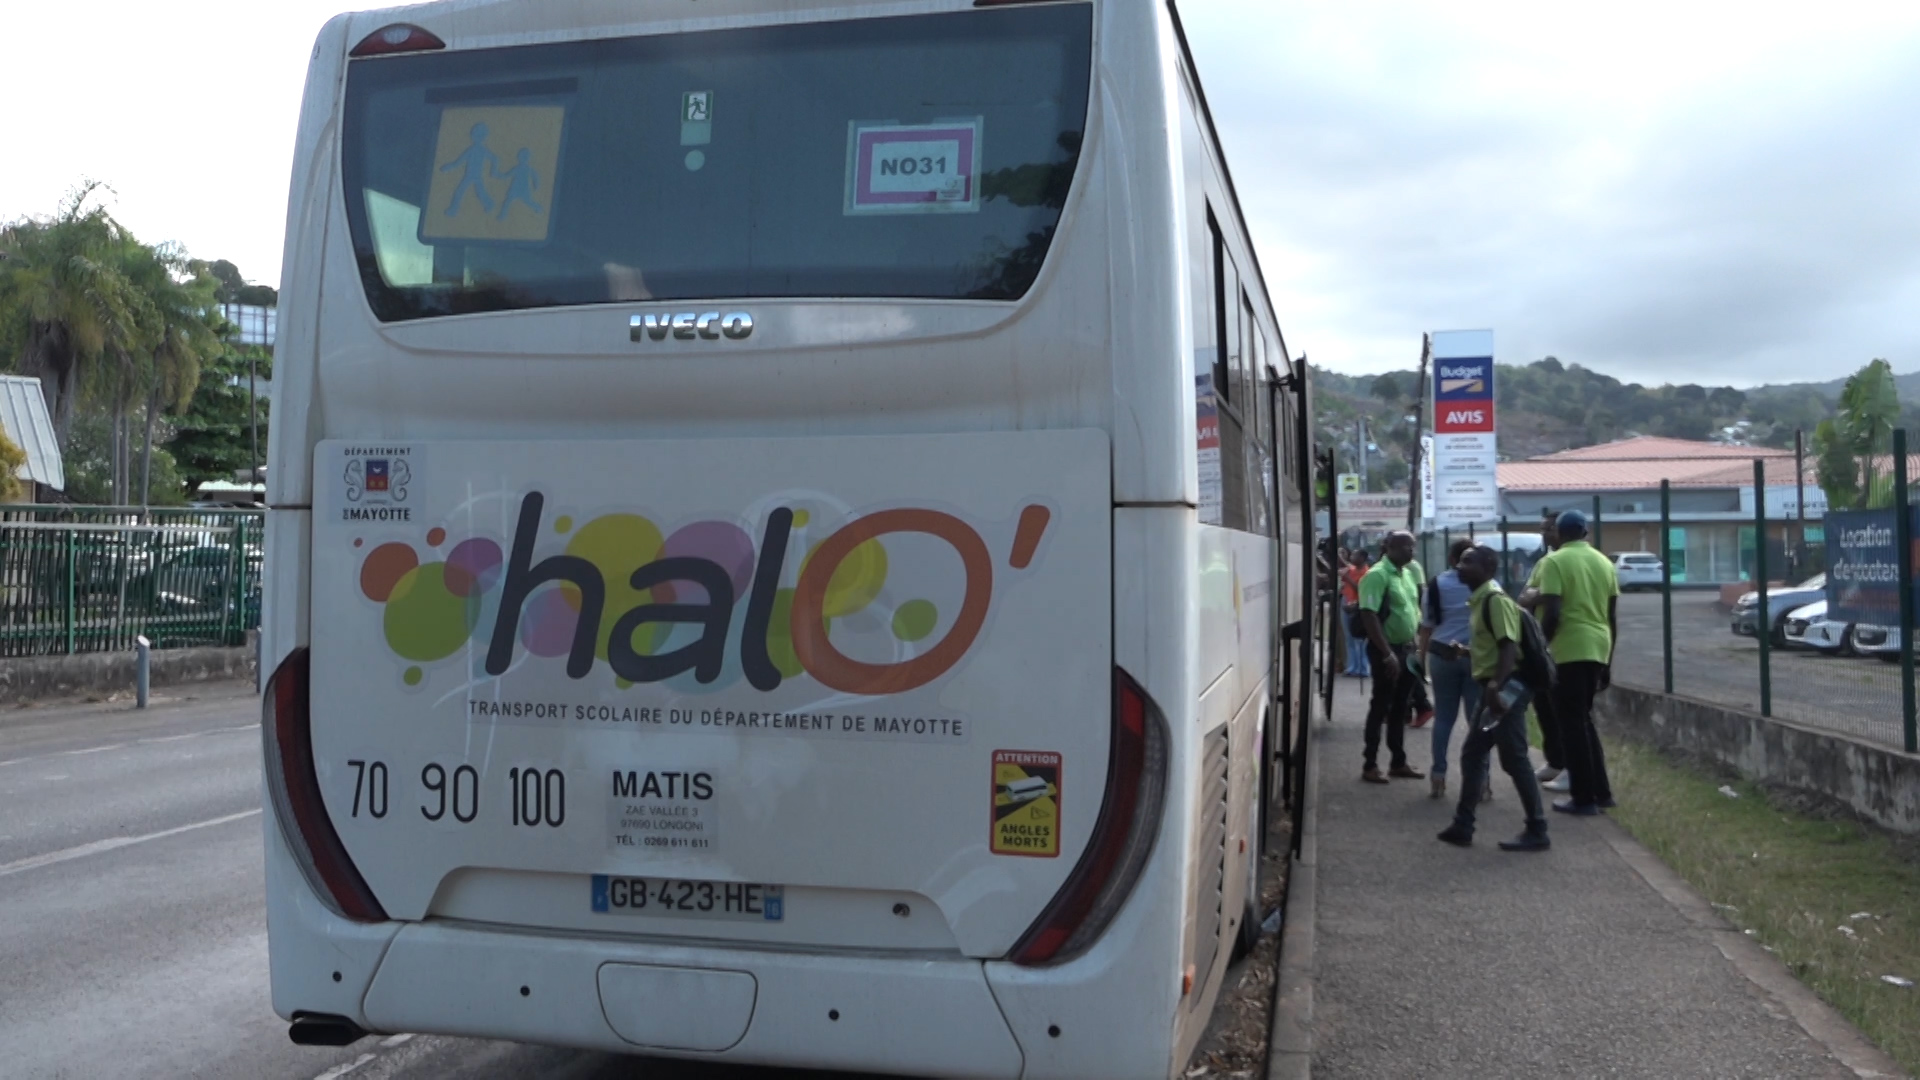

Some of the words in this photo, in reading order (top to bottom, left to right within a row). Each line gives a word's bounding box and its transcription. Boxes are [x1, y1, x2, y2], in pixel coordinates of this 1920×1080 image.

[881, 156, 947, 176] NO31
[629, 311, 754, 342] IVECO
[1440, 365, 1483, 380] Budget
[1445, 410, 1485, 425] AVIS
[344, 446, 411, 456] DÉPARTEMENT
[350, 507, 411, 521] MAYOTTE
[1840, 523, 1893, 549] Location
[469, 700, 568, 719] TRANSPORT
[575, 704, 662, 723] SCOLAIRE
[669, 708, 693, 725] DU
[700, 707, 835, 731] DÉPARTEMENT
[842, 714, 866, 733] DE
[873, 716, 963, 737] MAYOTTE
[996, 753, 1058, 764] ATTENTION
[612, 770, 714, 801] MATIS
[347, 759, 389, 819] 70
[420, 762, 479, 824] 90
[509, 766, 566, 828] 100
[625, 805, 646, 816] ZAE
[653, 819, 704, 832] LONGONI
[1001, 823, 1050, 837] ANGLES
[1003, 835, 1048, 848] MORTS
